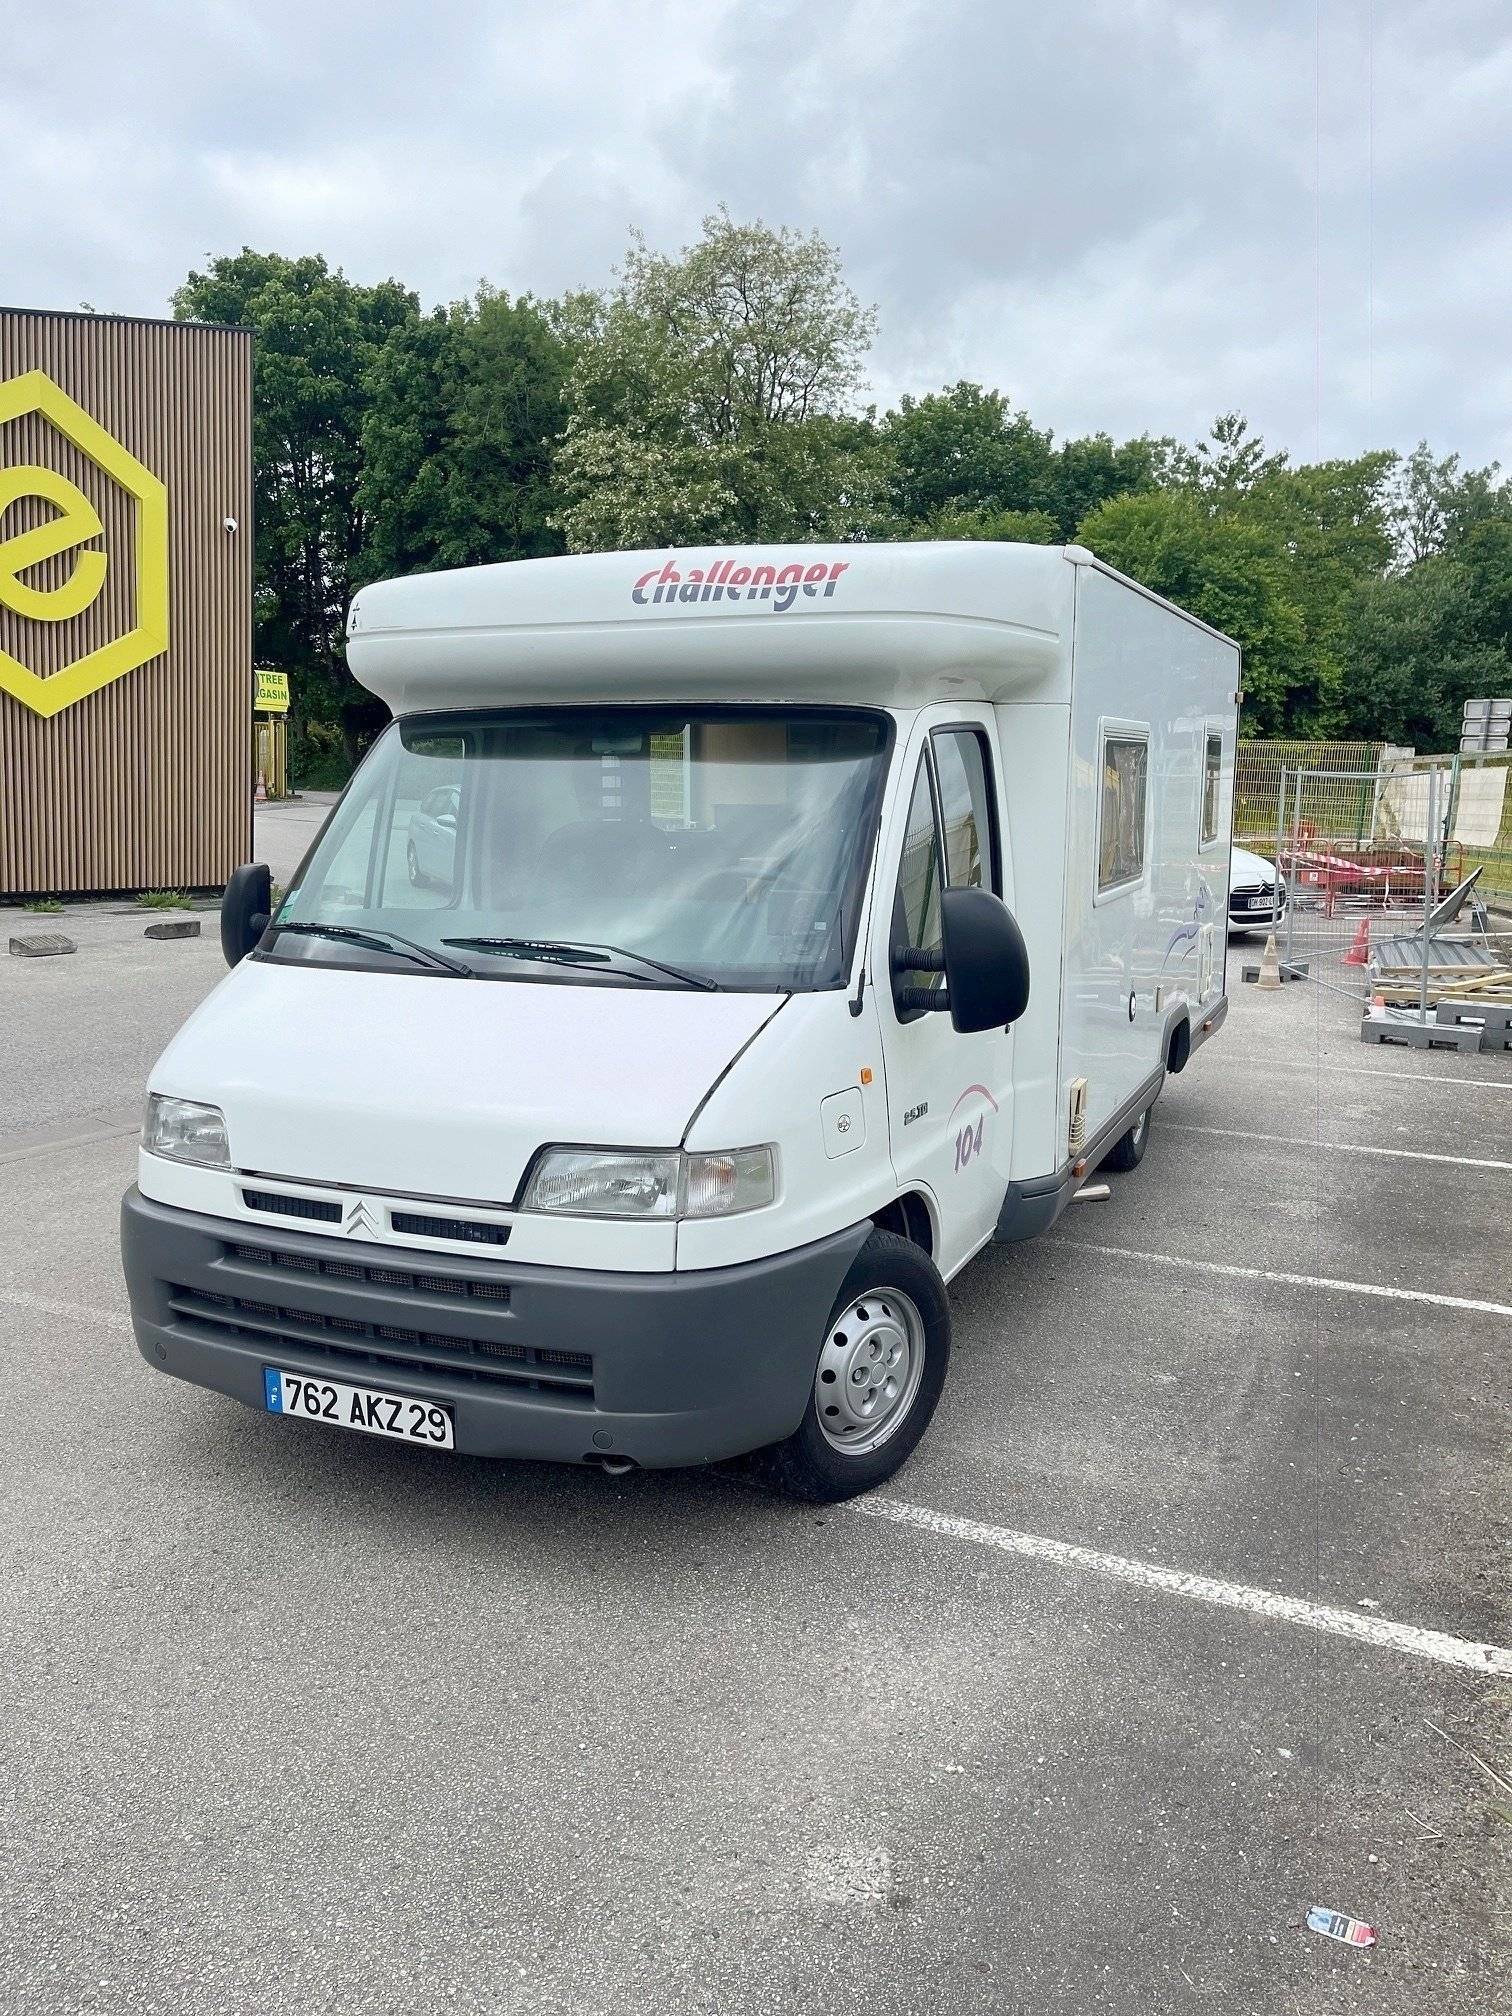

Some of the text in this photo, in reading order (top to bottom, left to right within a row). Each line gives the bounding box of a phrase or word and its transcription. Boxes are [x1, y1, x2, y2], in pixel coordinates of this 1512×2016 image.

[257, 673, 283, 685] TREE
[285, 1378, 339, 1420] 762
[350, 1392, 404, 1434] AKZ
[408, 1404, 446, 1442] 29
